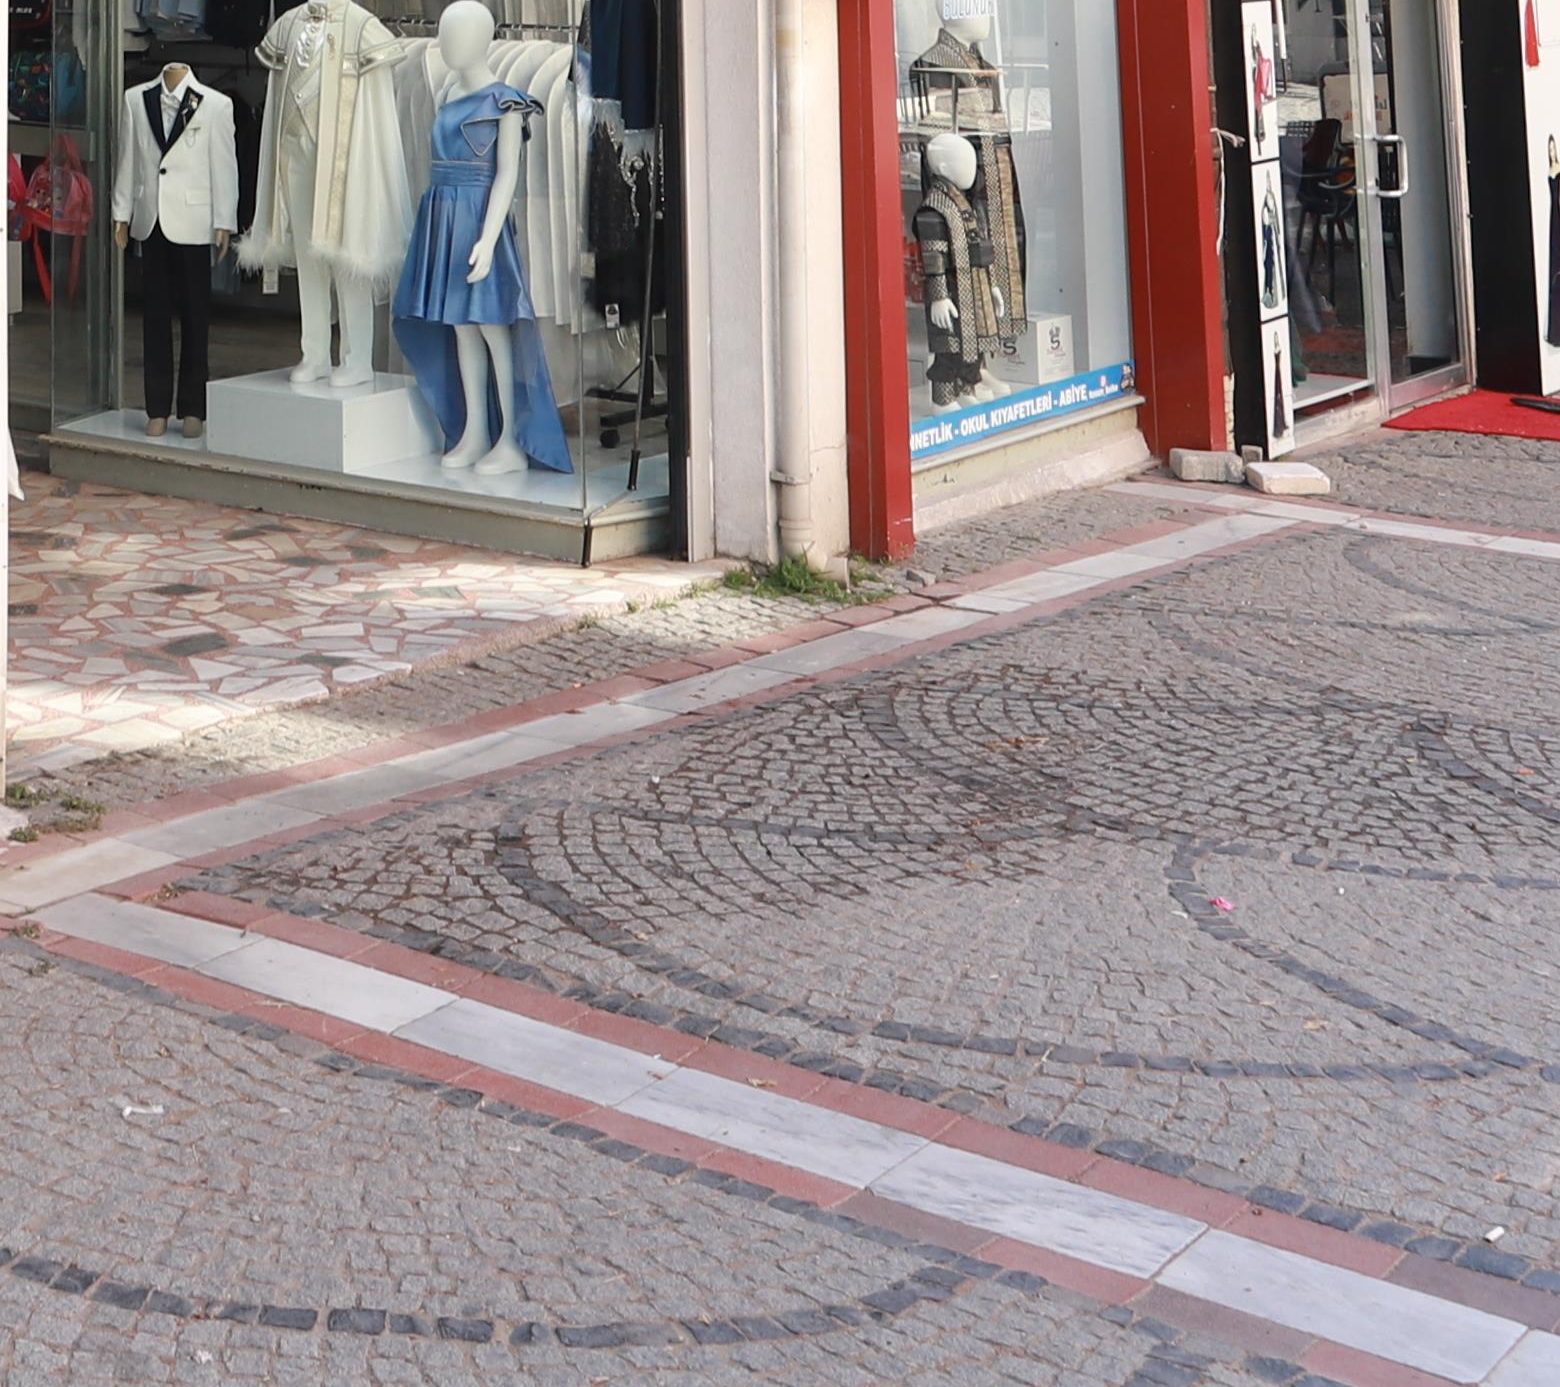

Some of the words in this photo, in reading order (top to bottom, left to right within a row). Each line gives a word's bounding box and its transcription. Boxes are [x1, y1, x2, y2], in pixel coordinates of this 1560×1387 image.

[960, 417, 990, 438] OKUL
[990, 390, 1053, 428] KIYAFETLERİ
[1058, 383, 1089, 408] ABİYE
